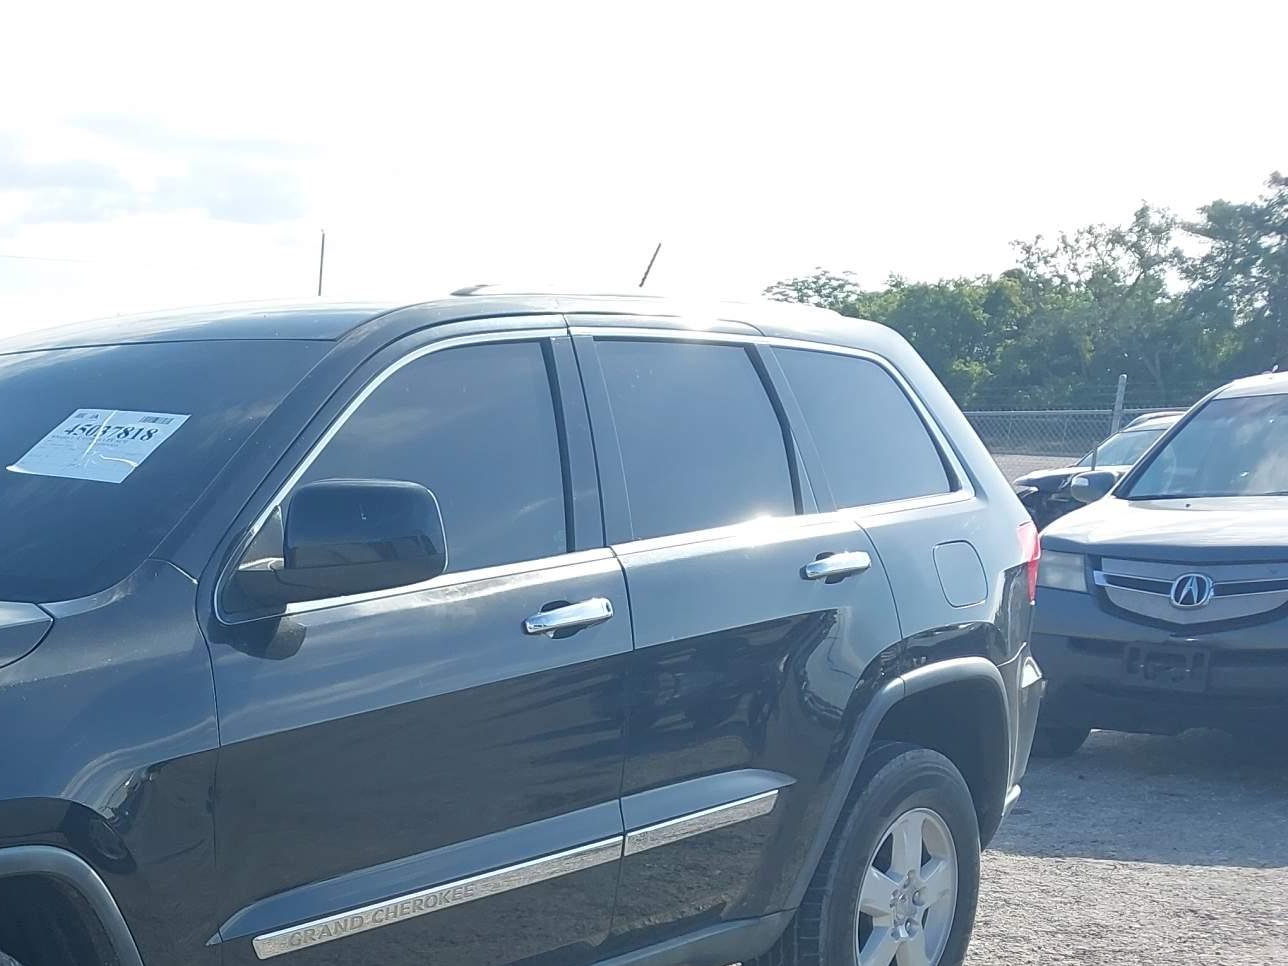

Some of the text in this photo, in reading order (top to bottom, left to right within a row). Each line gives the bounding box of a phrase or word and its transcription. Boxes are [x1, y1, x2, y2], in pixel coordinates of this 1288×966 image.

[64, 424, 158, 441] 45037818
[289, 884, 475, 948] GRAND CHEROKEE
